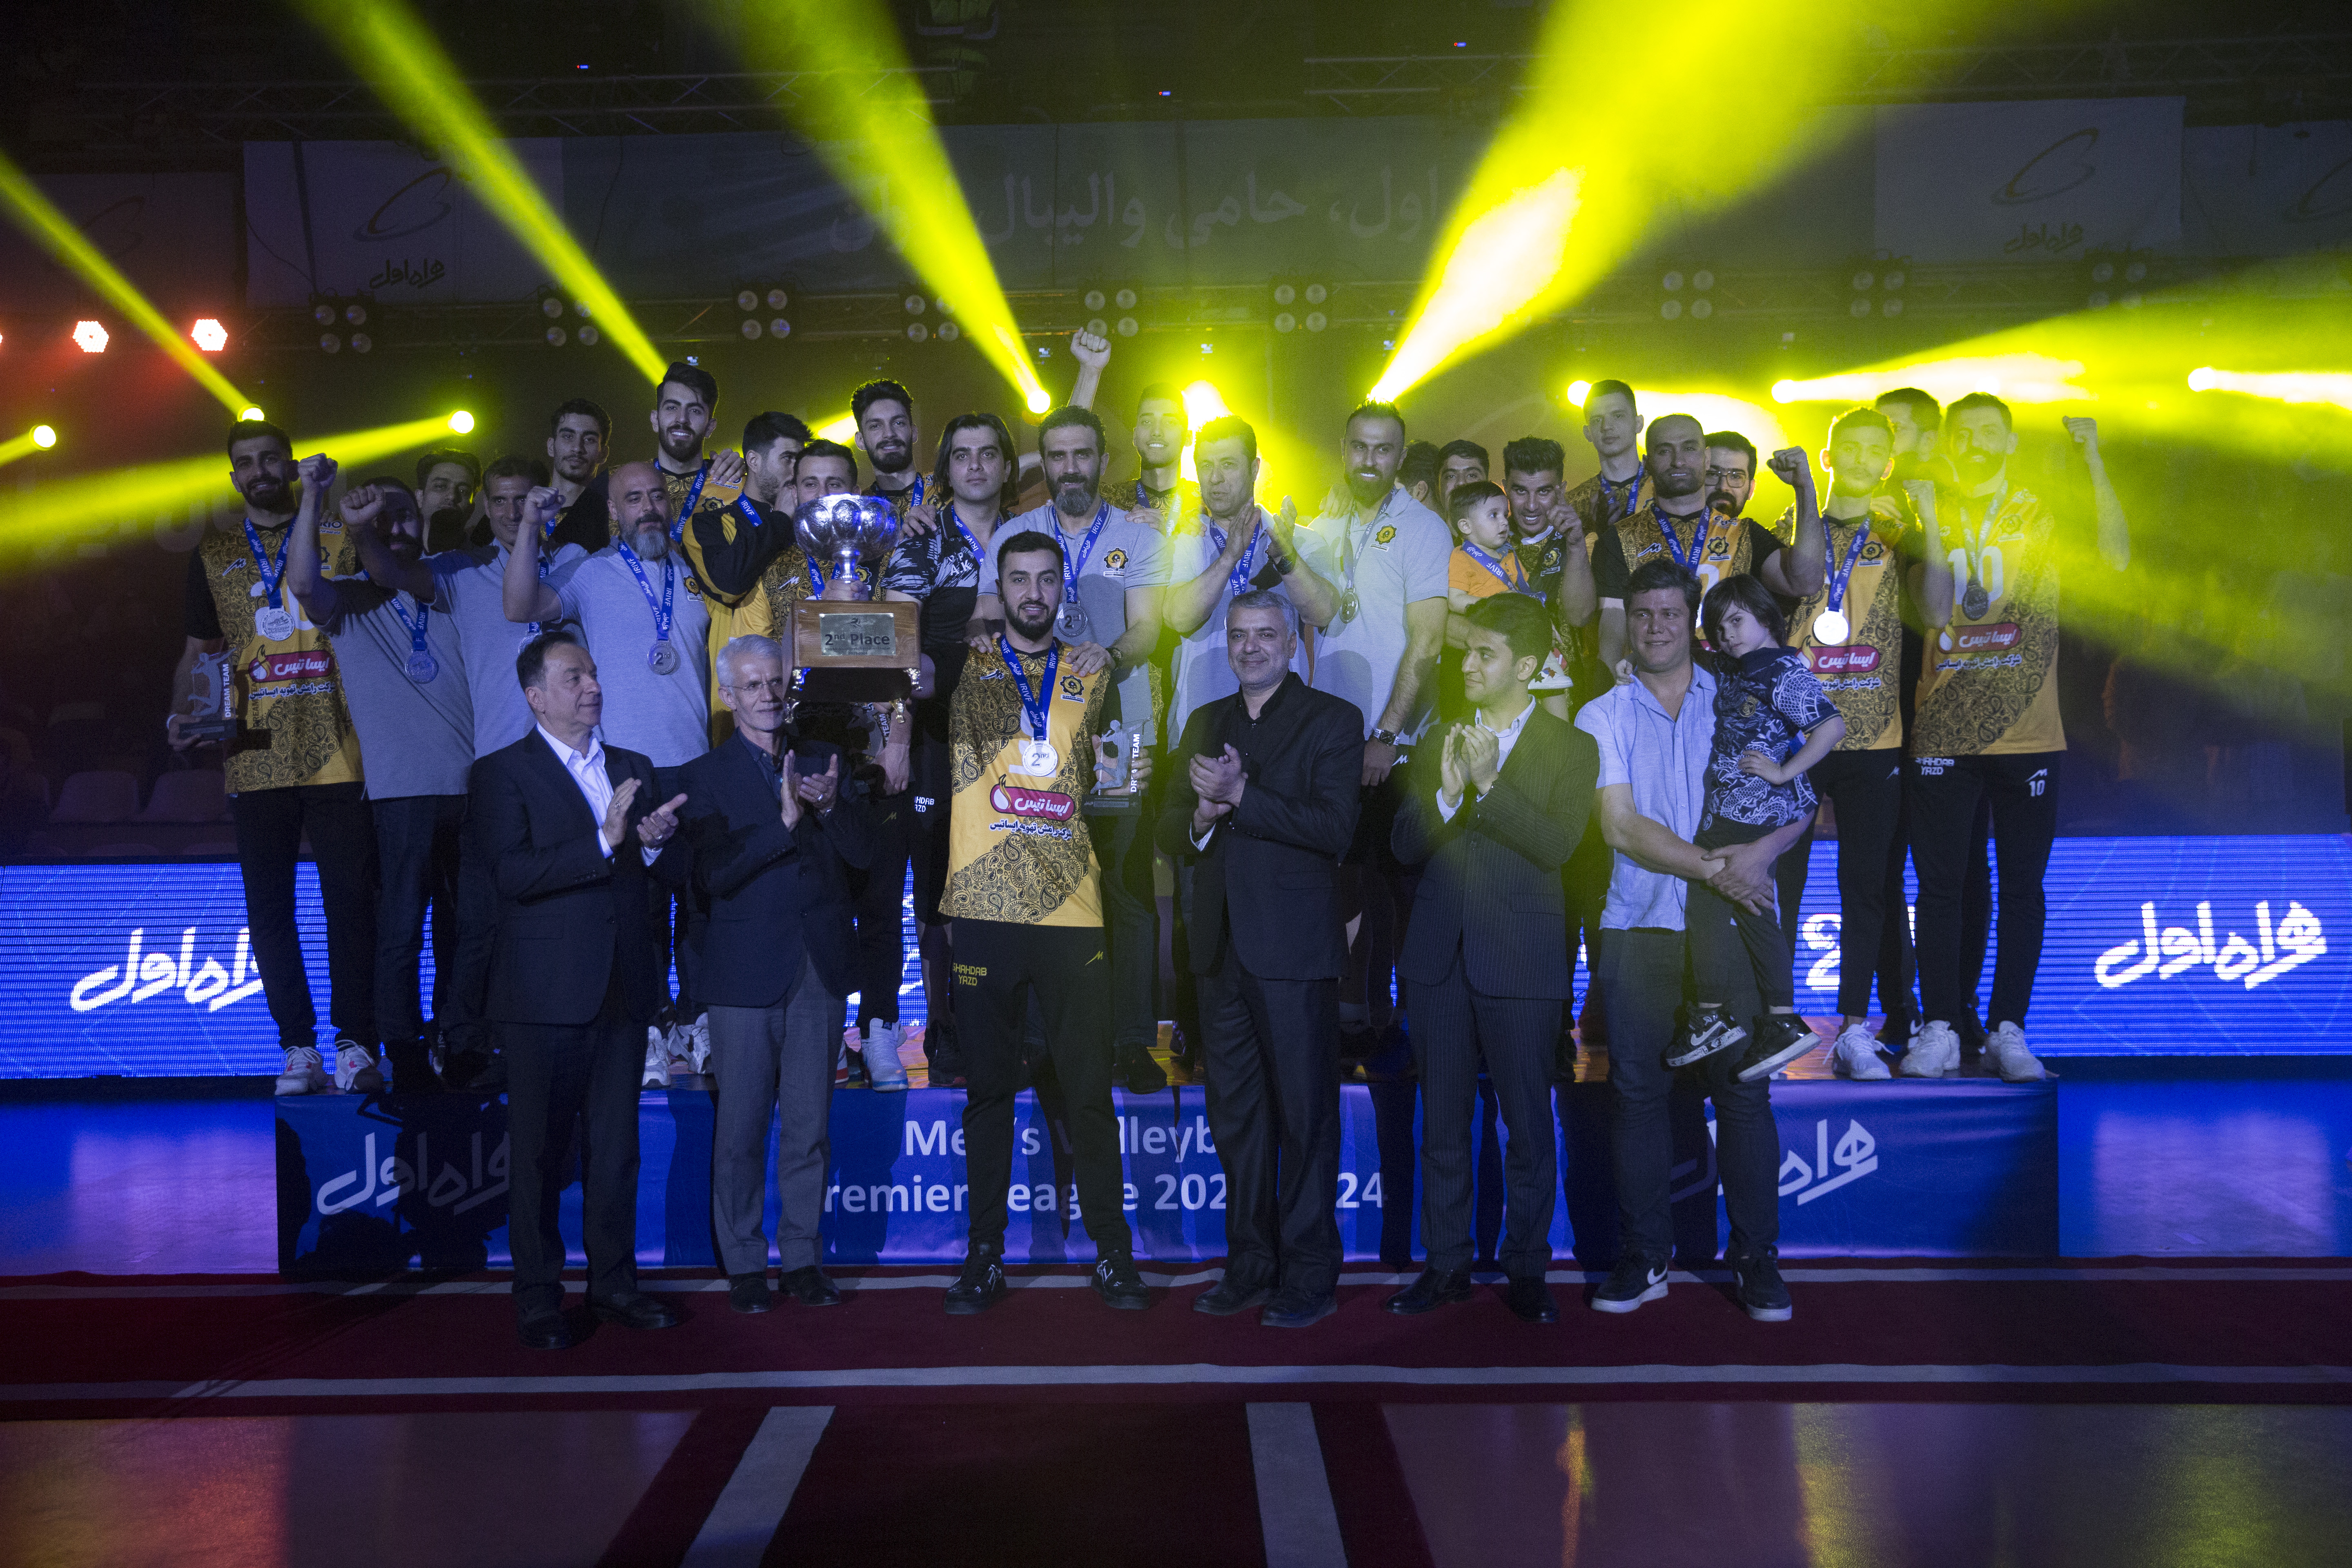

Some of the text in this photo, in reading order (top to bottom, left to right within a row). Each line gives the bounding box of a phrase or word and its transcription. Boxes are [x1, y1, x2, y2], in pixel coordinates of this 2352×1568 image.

[695, 472, 705, 490] IRIVF
[740, 500, 755, 516] IRIVF
[1626, 499, 1635, 515] IRIV
[676, 516, 687, 534] IRIVF
[1091, 515, 1103, 535] IRIVF
[1659, 518, 1670, 533] IRIVF
[964, 534, 979, 552] IRIVF
[1242, 550, 1252, 568] IRIVF
[1690, 546, 1702, 564] IRIVF
[259, 558, 272, 577] IRIVF
[274, 559, 284, 578] IRIVF
[626, 558, 641, 574] IRIVF
[1486, 562, 1504, 578] IRIVF
[1841, 558, 1854, 578] IRIVF
[1947, 546, 2004, 605] 10
[1231, 579, 1241, 595] RIVF
[390, 598, 403, 610] IRIV
[664, 587, 673, 607] IRIVF
[417, 612, 426, 630] IRIVF
[653, 606, 662, 625] RIVF
[825, 632, 890, 646] 2nd Place
[1959, 628, 2017, 648] ایساتیس
[274, 657, 330, 676] ایساتیس
[1048, 651, 1058, 669] IRIVF
[1817, 652, 1876, 669] ایساتیس
[1019, 683, 1033, 702] IRIVF
[879, 713, 891, 736] TEAM
[1031, 753, 1049, 766] 2nd
[1130, 733, 1140, 793] DRA TEAM
[1921, 766, 1944, 776] YAZD
[2029, 779, 2046, 797] 10
[914, 796, 935, 806] HDAB
[1014, 797, 1071, 816] ایساتیس
[990, 820, 1018, 831] ایساتیس
[953, 962, 987, 976] SHAHDAB
[958, 974, 978, 986] YAZD
[905, 1119, 1041, 1156] Me's
[825, 1174, 969, 1213] remier
[1007, 1180, 1140, 1221] eage
